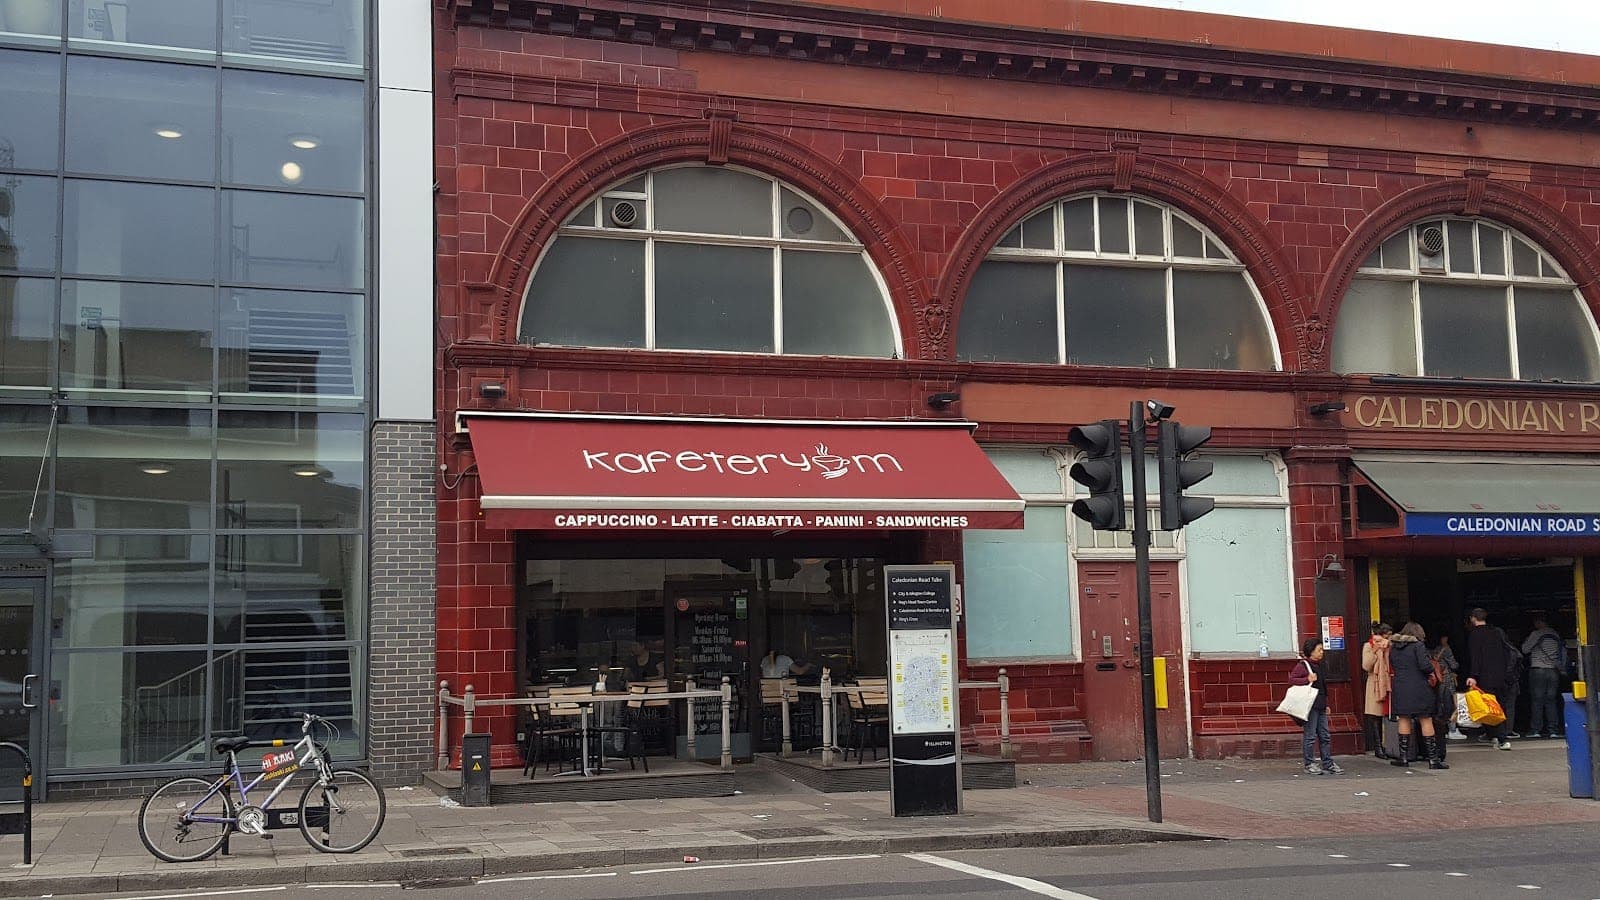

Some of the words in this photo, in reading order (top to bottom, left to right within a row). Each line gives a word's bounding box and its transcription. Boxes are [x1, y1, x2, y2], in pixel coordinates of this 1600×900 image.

[1354, 395, 1566, 432] CALEDONIAN
[554, 514, 658, 527] CAPPUCCINO
[671, 515, 719, 527] LATTE
[731, 515, 804, 527] CIABATTA
[815, 516, 864, 527] PANINI
[876, 516, 969, 527] SANDWICHES
[1446, 517, 1542, 532] CALEDONIAN
[1547, 518, 1586, 532] ROAD
